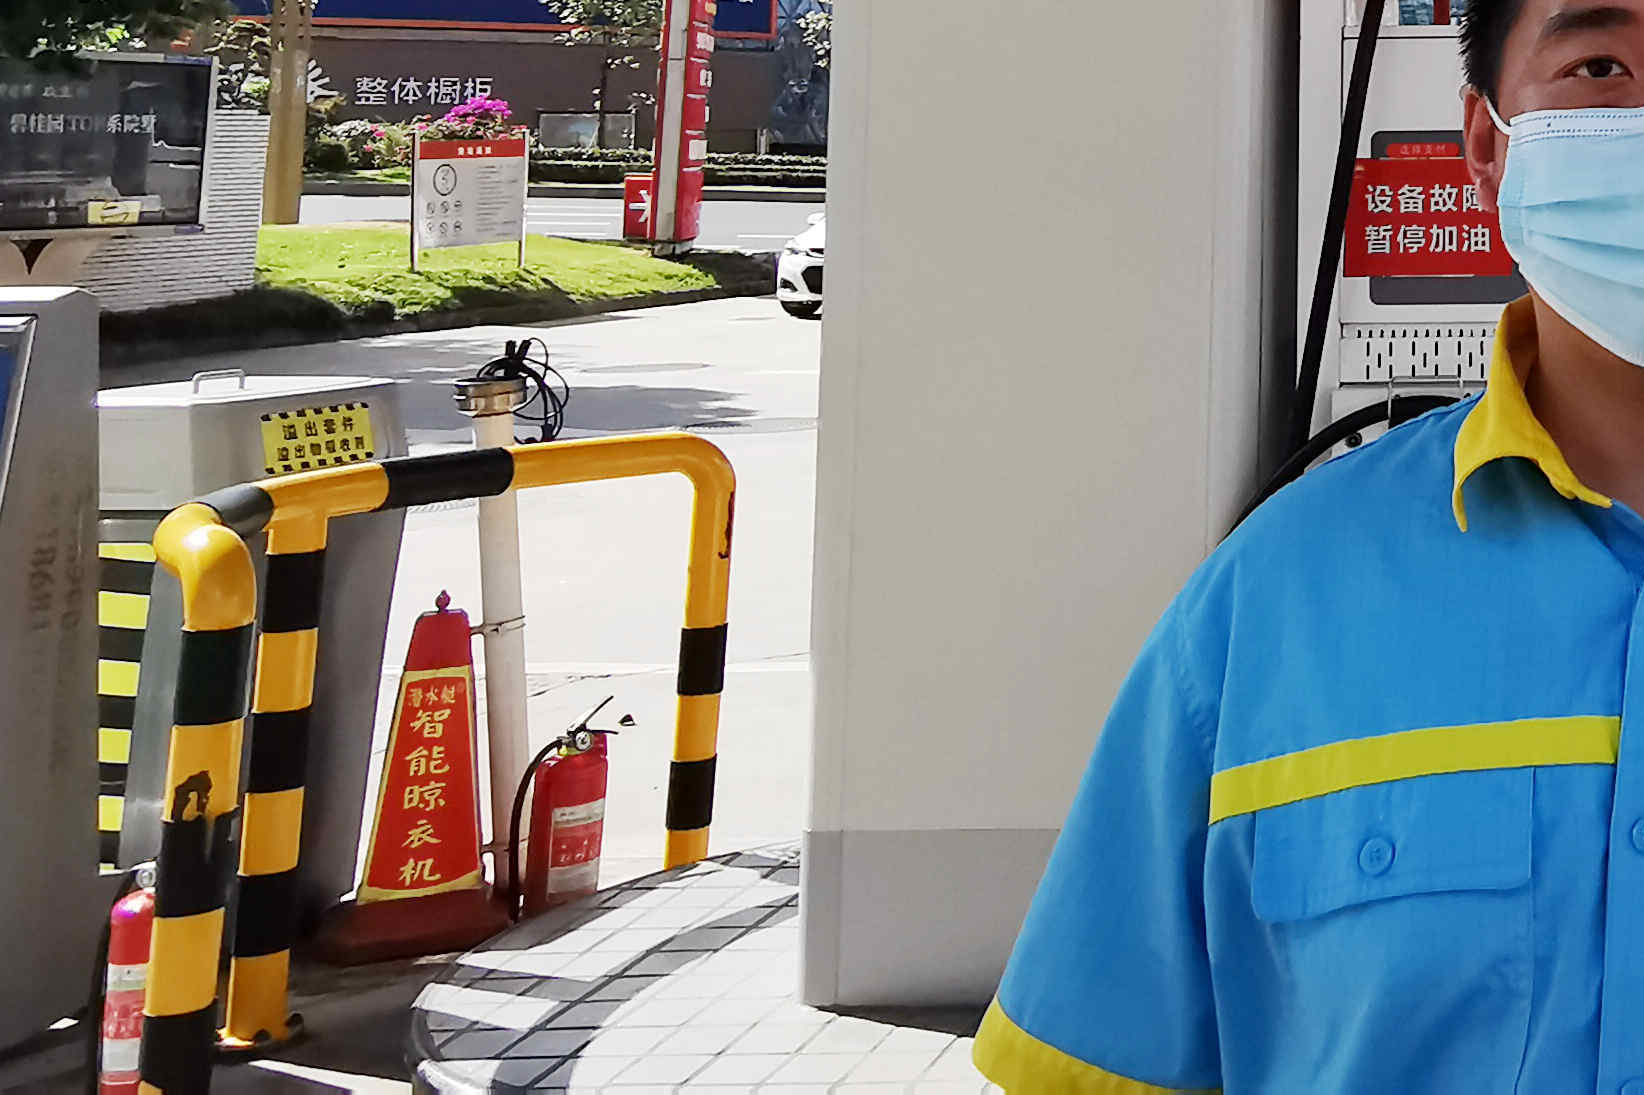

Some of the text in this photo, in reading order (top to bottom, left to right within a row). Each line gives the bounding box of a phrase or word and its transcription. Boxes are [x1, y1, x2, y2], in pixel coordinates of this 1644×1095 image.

[354, 75, 494, 106] 整体橱柜
[1364, 223, 1492, 254] 暂停加油
[398, 708, 452, 886] 智能晾衣机
